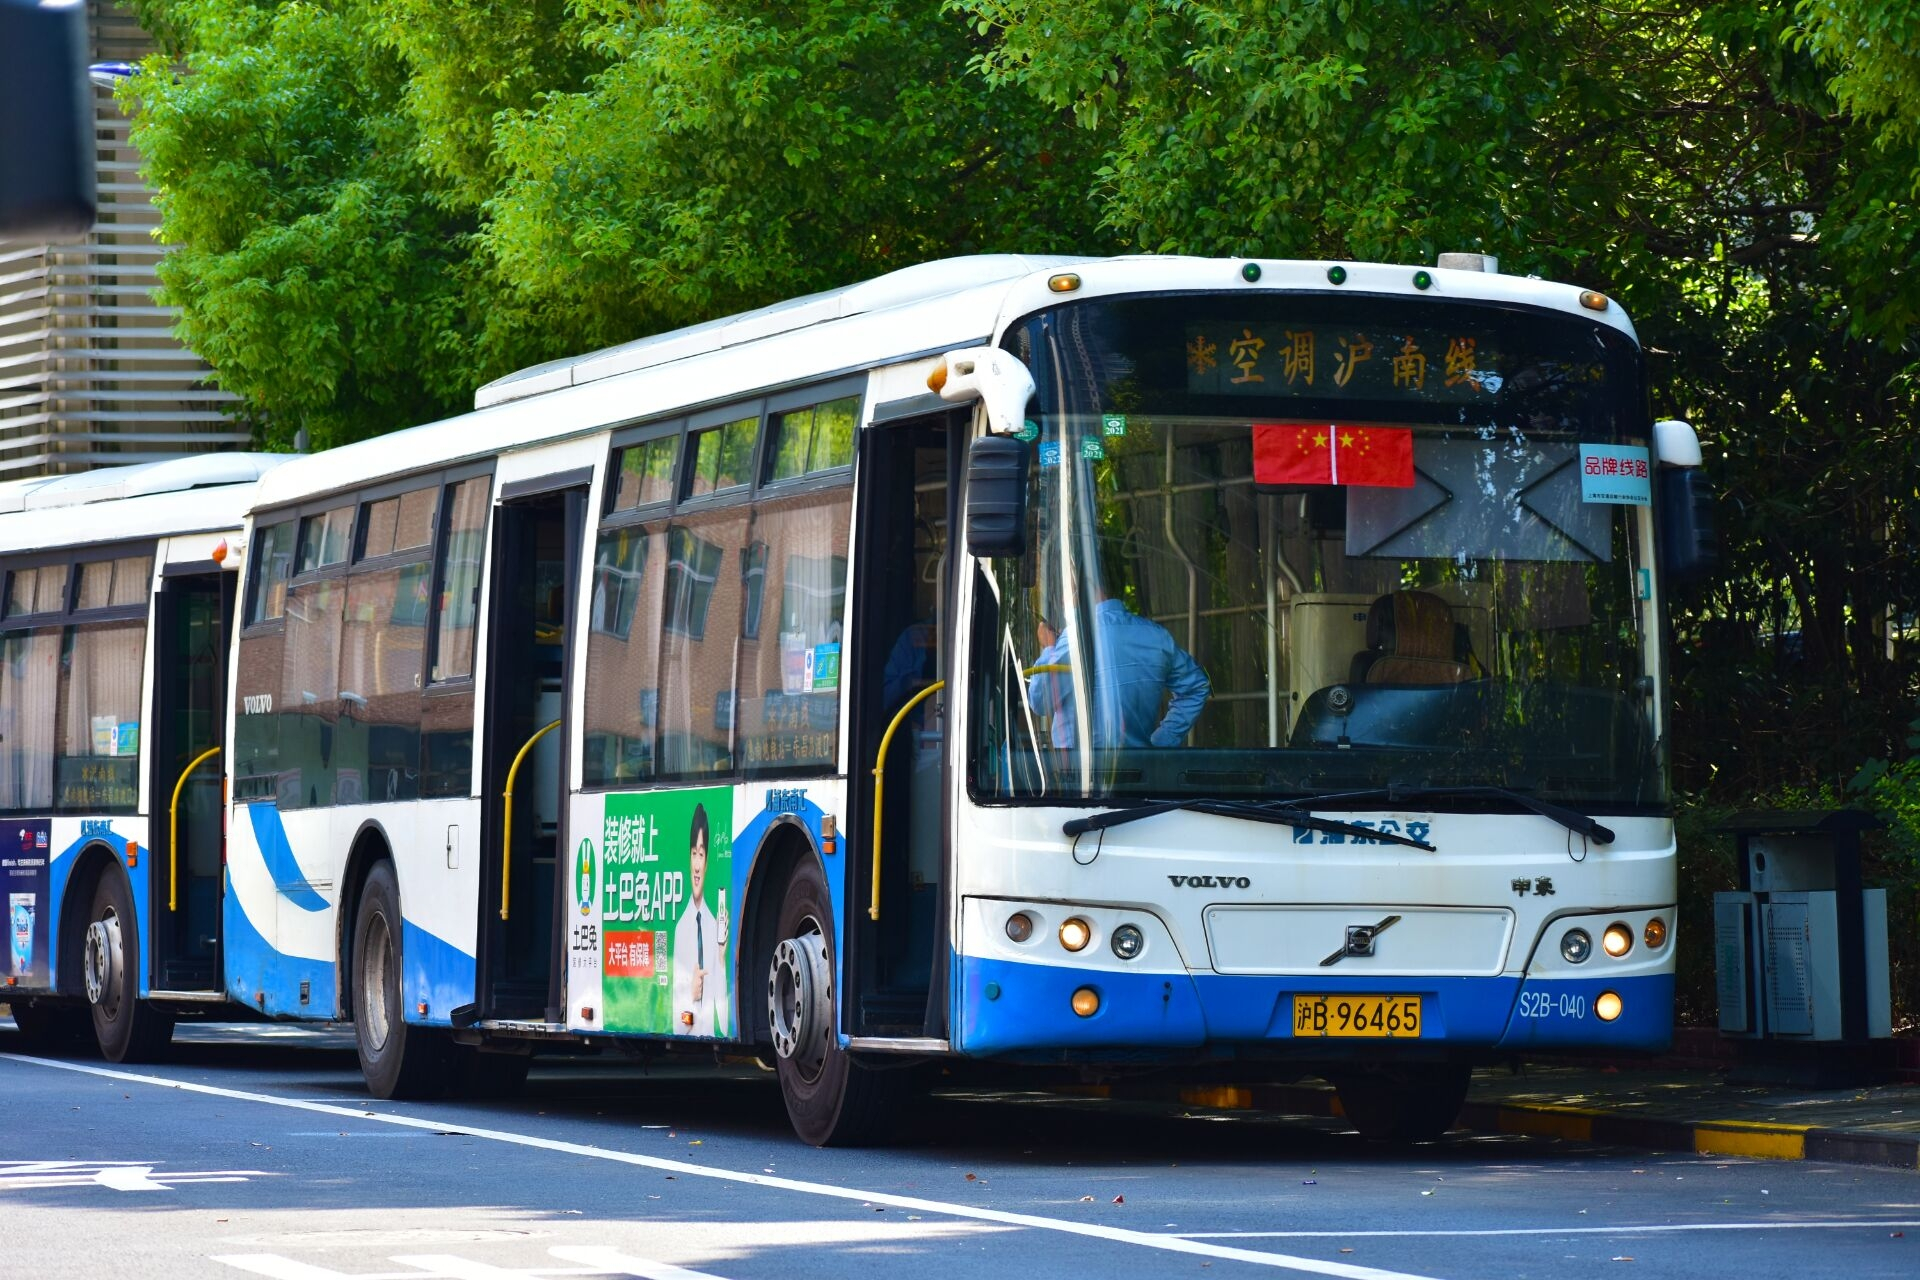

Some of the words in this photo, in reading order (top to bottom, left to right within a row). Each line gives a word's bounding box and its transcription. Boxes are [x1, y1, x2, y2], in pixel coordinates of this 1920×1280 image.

[1229, 328, 1482, 392] 空调沪南线
[1105, 426, 1124, 435] 2021
[1083, 450, 1102, 459] 2021
[1585, 456, 1648, 479] 品牌线路
[243, 694, 273, 715] VOLVO
[604, 815, 659, 866] 装修就上
[1169, 876, 1251, 889] VOLVO
[603, 871, 683, 922] 土巴兔APP
[573, 925, 597, 951] 土巴兔
[608, 943, 628, 966] 大平台
[629, 943, 650, 967] 有保障
[1519, 993, 1586, 1019] S2B-040
